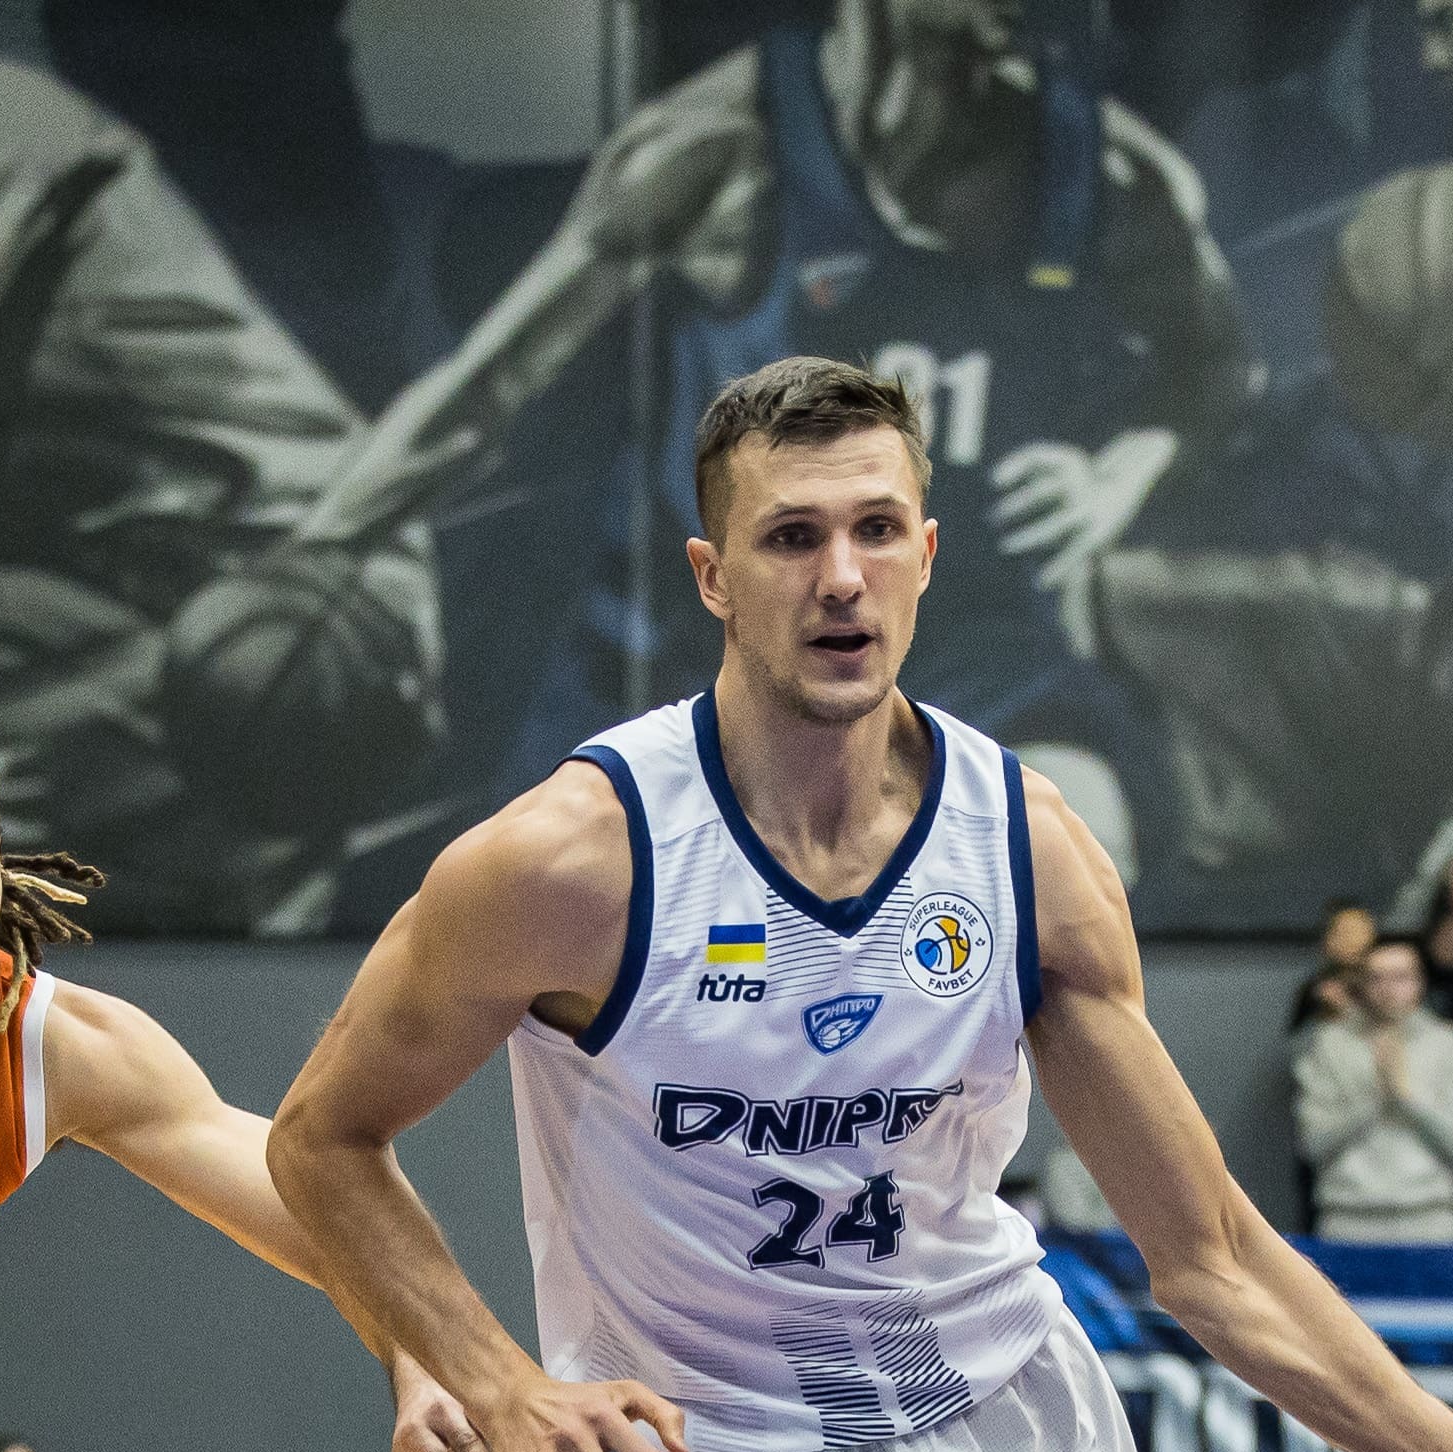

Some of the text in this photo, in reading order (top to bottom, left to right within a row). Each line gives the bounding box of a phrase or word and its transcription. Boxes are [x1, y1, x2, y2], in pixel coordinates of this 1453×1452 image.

[909, 901, 978, 931] SUPERLEAGUE
[928, 968, 973, 991] FAVBET
[748, 1169, 906, 1270] 24
